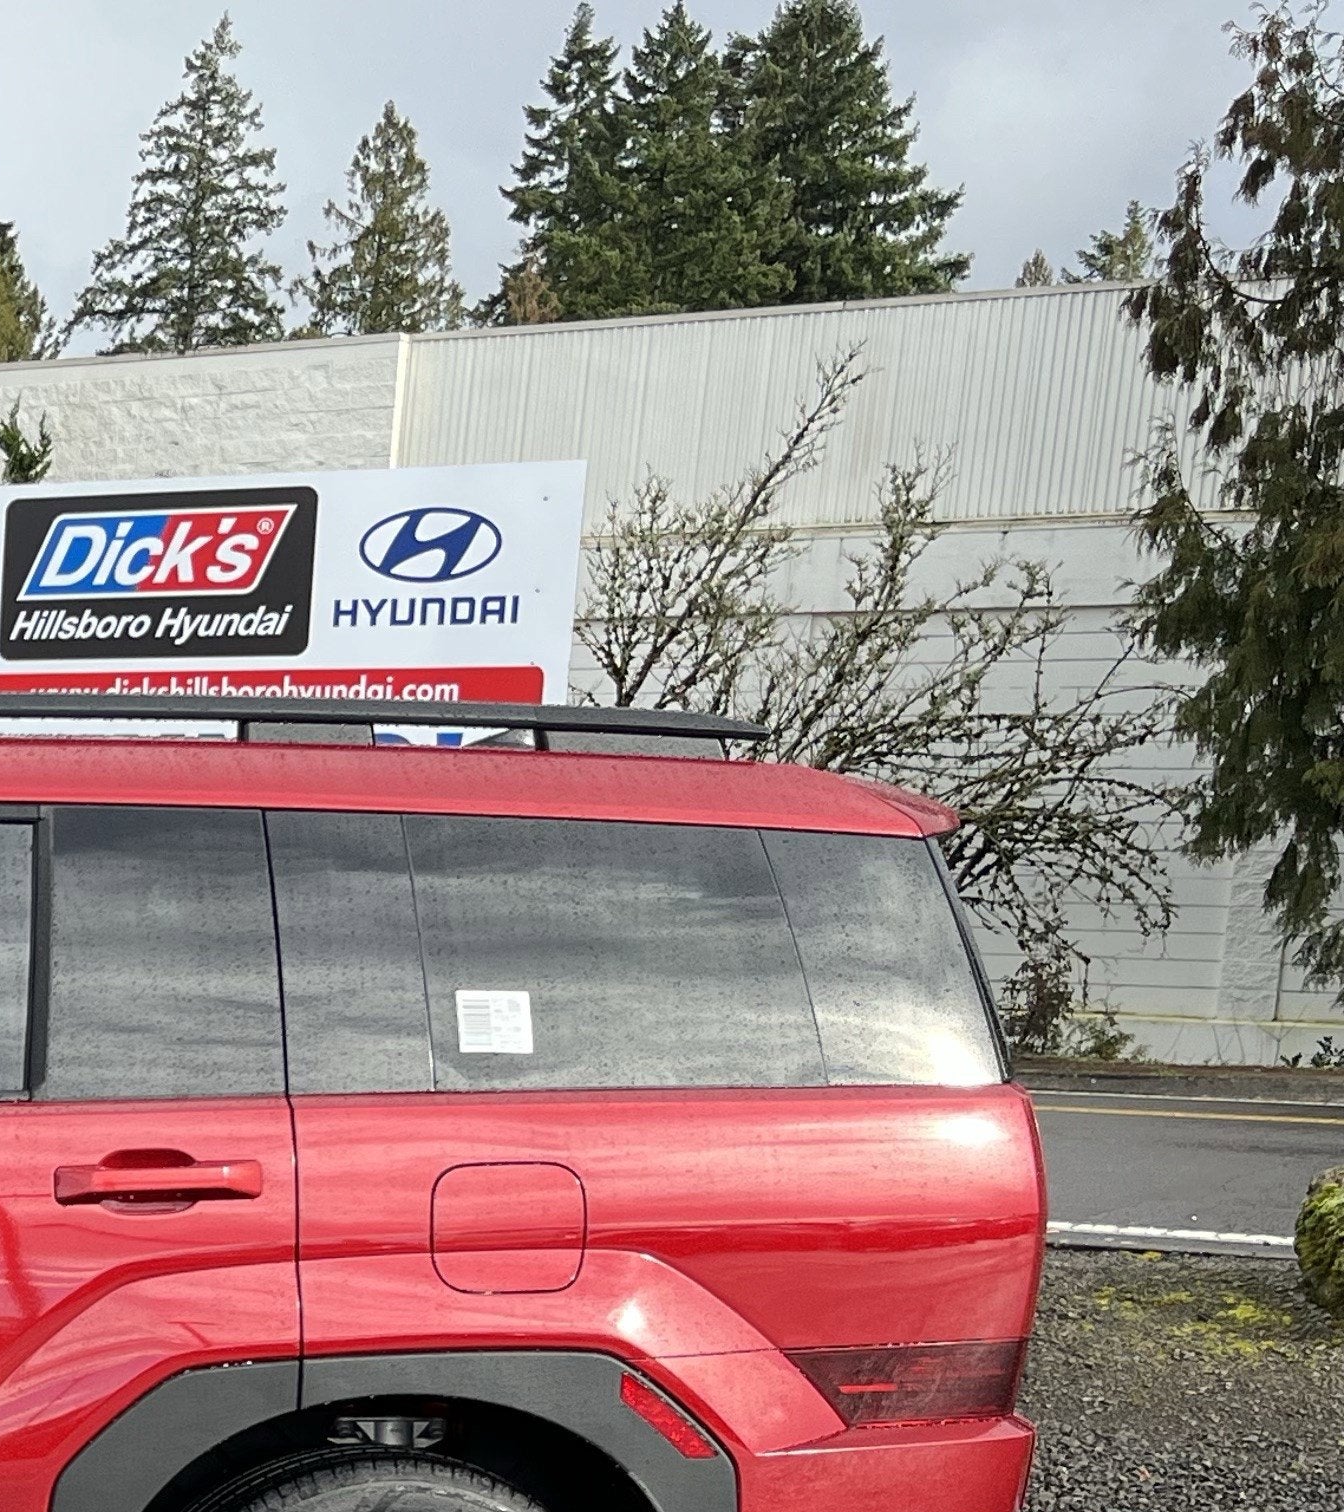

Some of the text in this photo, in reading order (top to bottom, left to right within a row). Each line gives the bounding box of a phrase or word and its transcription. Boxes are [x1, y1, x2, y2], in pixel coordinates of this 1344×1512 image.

[9, 604, 294, 646] Hillsboro Hyundai
[332, 595, 520, 628] HYUNDAI
